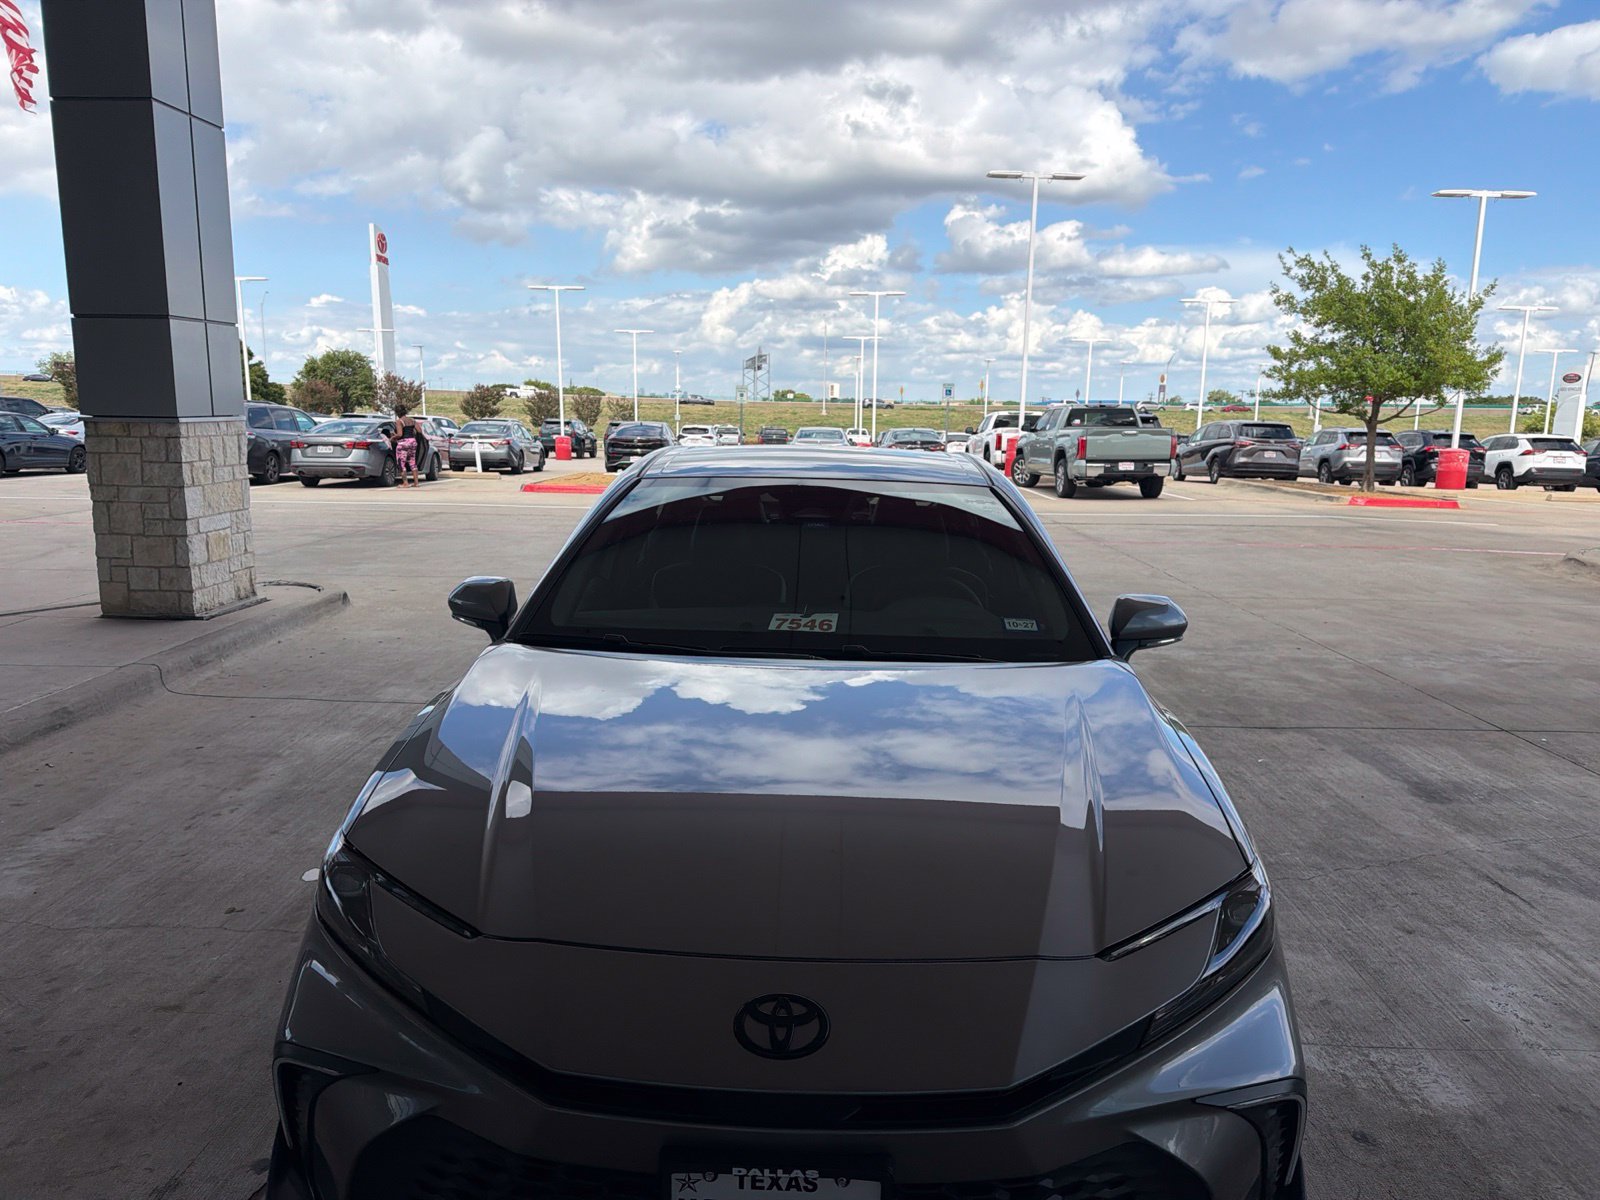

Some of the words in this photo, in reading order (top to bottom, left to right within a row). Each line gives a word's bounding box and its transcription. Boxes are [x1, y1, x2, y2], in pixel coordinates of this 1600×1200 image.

[775, 618, 833, 631] 7546
[732, 1167, 819, 1178] DALLAS
[736, 1174, 818, 1192] TEXAS
